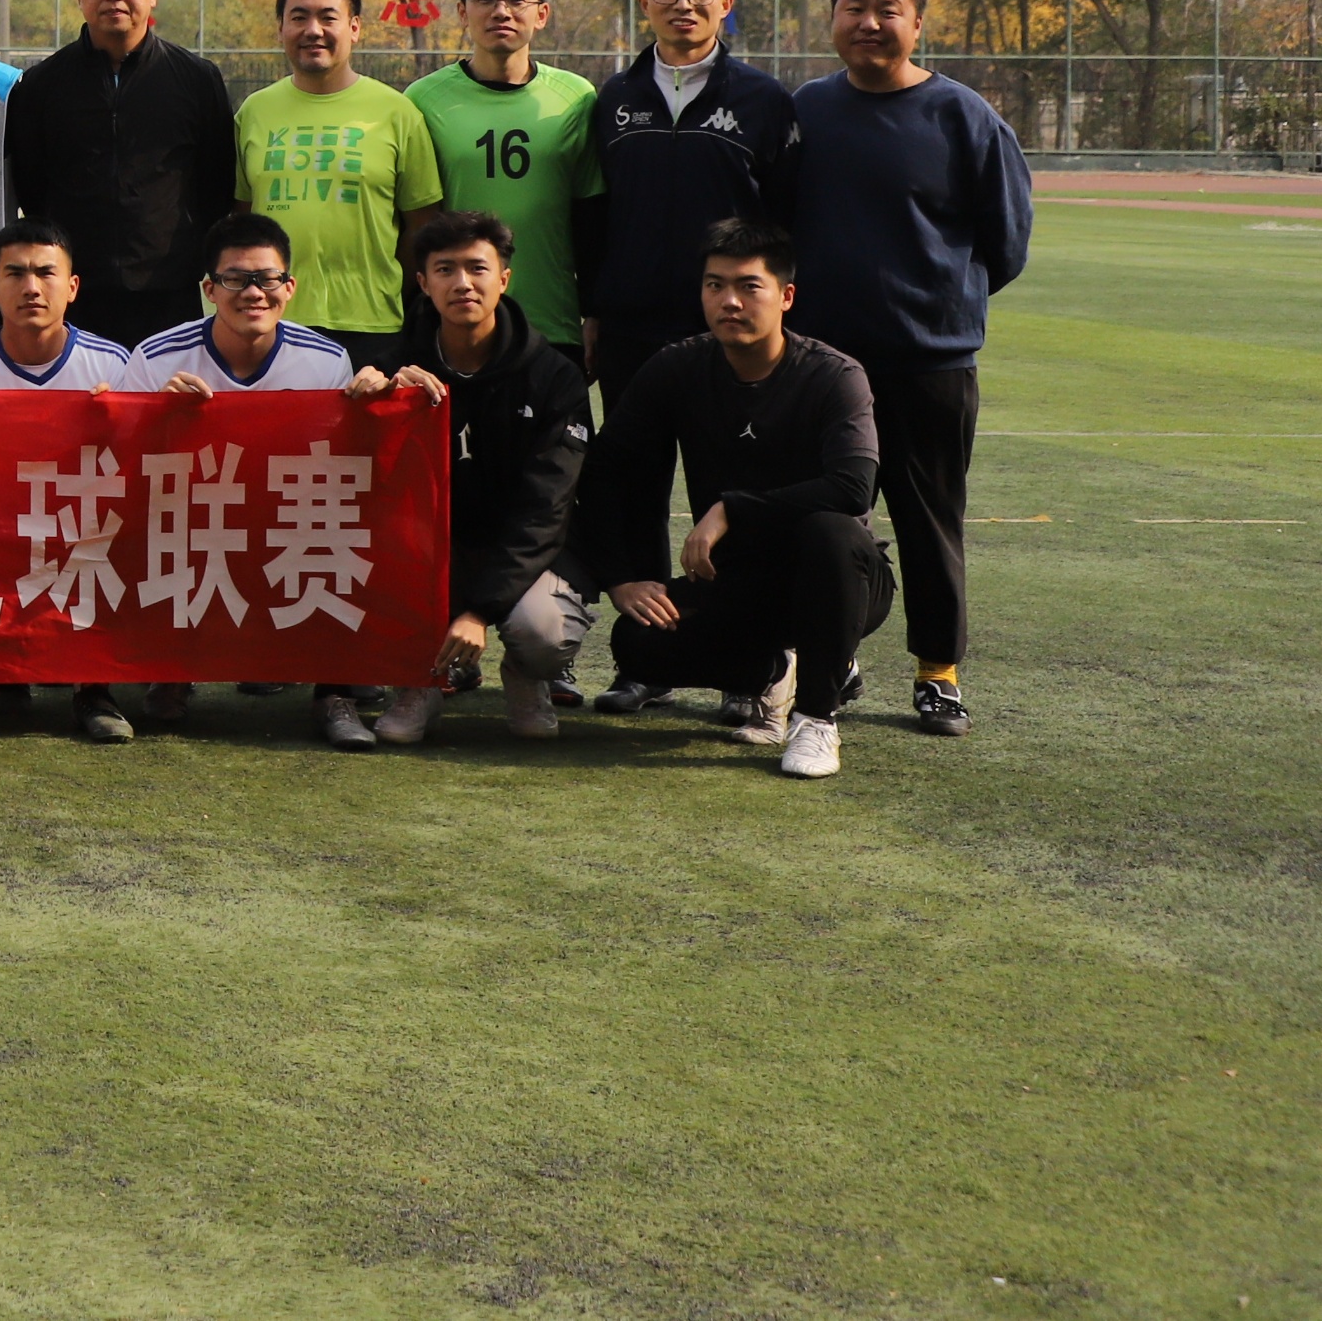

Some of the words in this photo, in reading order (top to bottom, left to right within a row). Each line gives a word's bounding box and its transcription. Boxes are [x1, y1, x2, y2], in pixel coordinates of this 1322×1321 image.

[267, 126, 365, 148] KEEP
[263, 149, 363, 174] HOPE
[476, 129, 530, 179] 16
[268, 177, 360, 205] ALIVE
